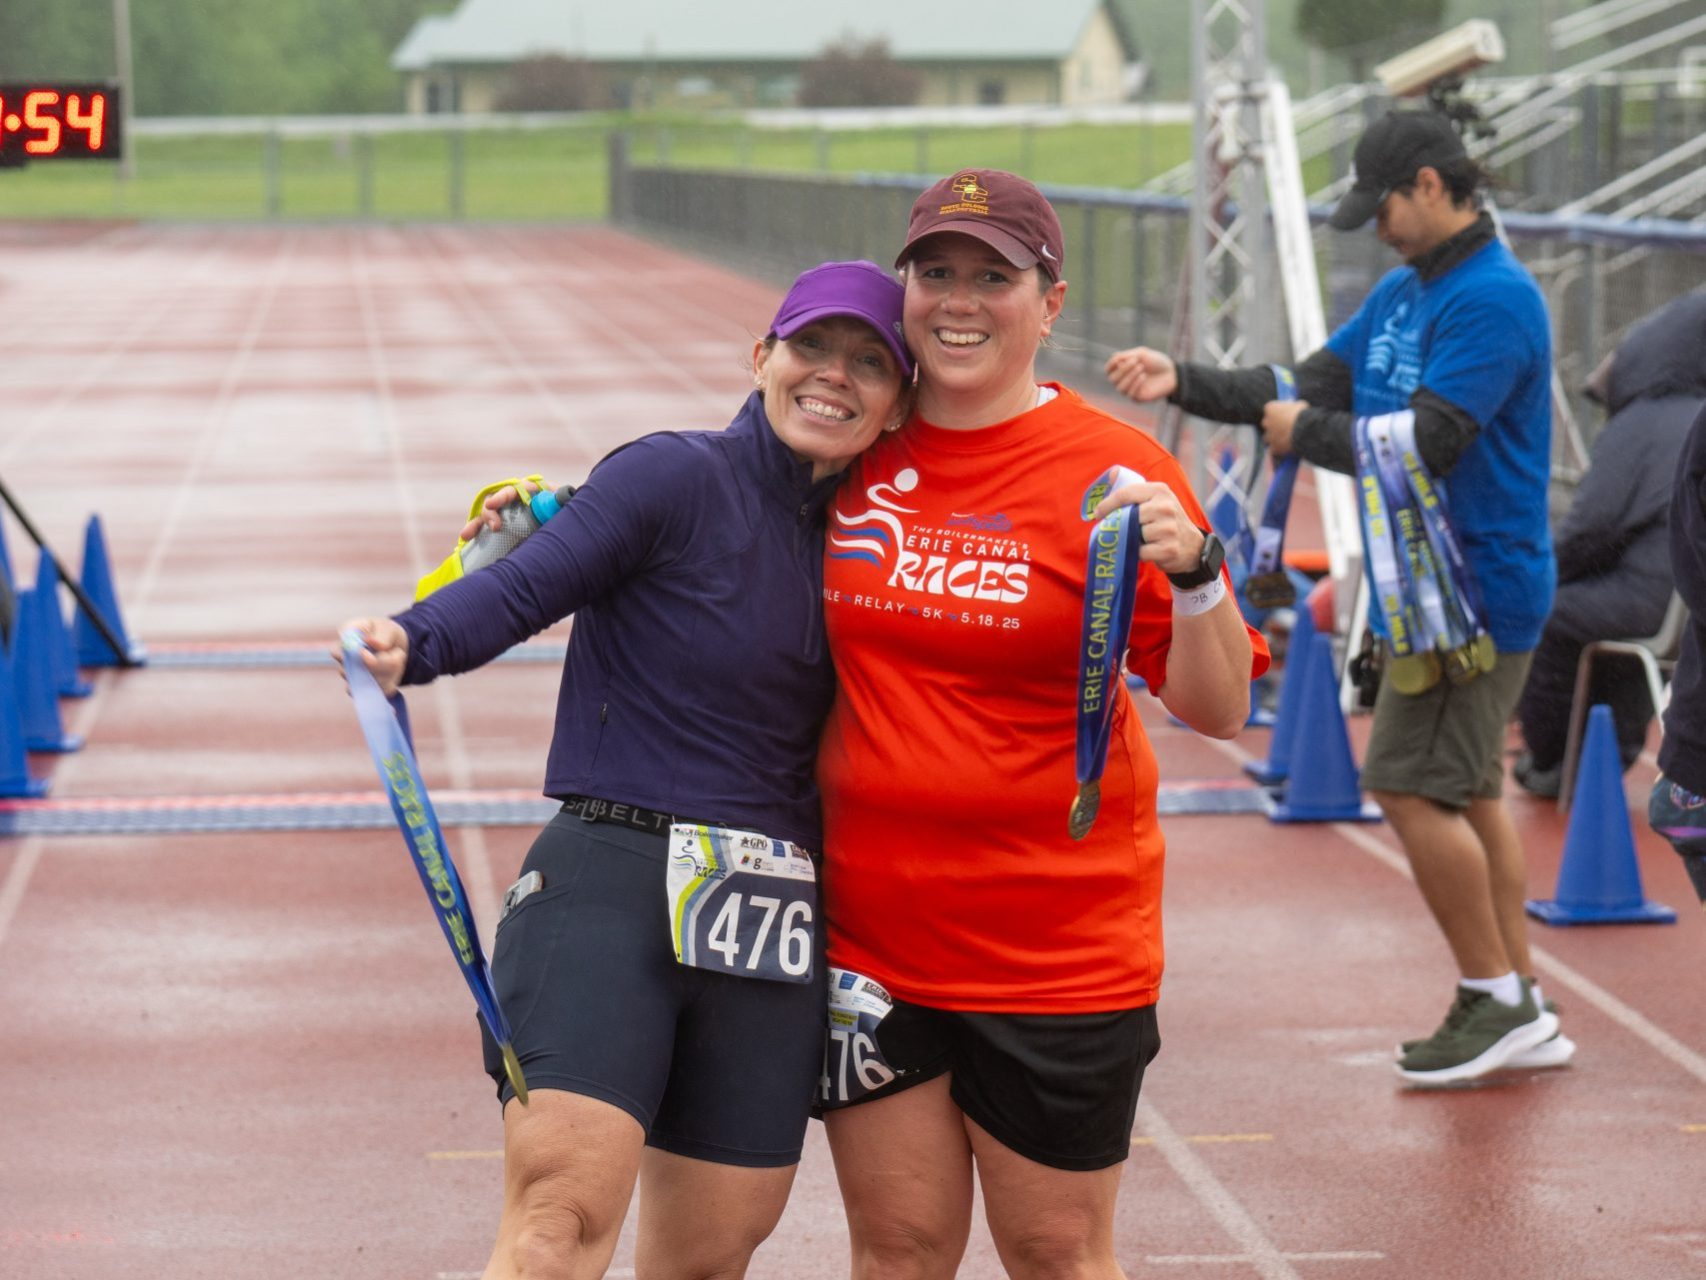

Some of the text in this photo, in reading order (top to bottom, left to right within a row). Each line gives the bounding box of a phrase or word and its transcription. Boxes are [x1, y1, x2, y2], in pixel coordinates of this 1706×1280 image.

[906, 534, 1032, 561] ERIE CANAL
[911, 525, 1028, 550] THE BOILERMAKER'S
[886, 549, 1029, 604] RACES
[854, 595, 905, 613] RELAY
[922, 607, 943, 619] 5K
[961, 612, 1020, 629] 5.18.25
[1088, 583, 1114, 659] CANAL
[1084, 664, 1104, 714] ERIE
[750, 838, 767, 848] GPO
[708, 892, 813, 976] 476
